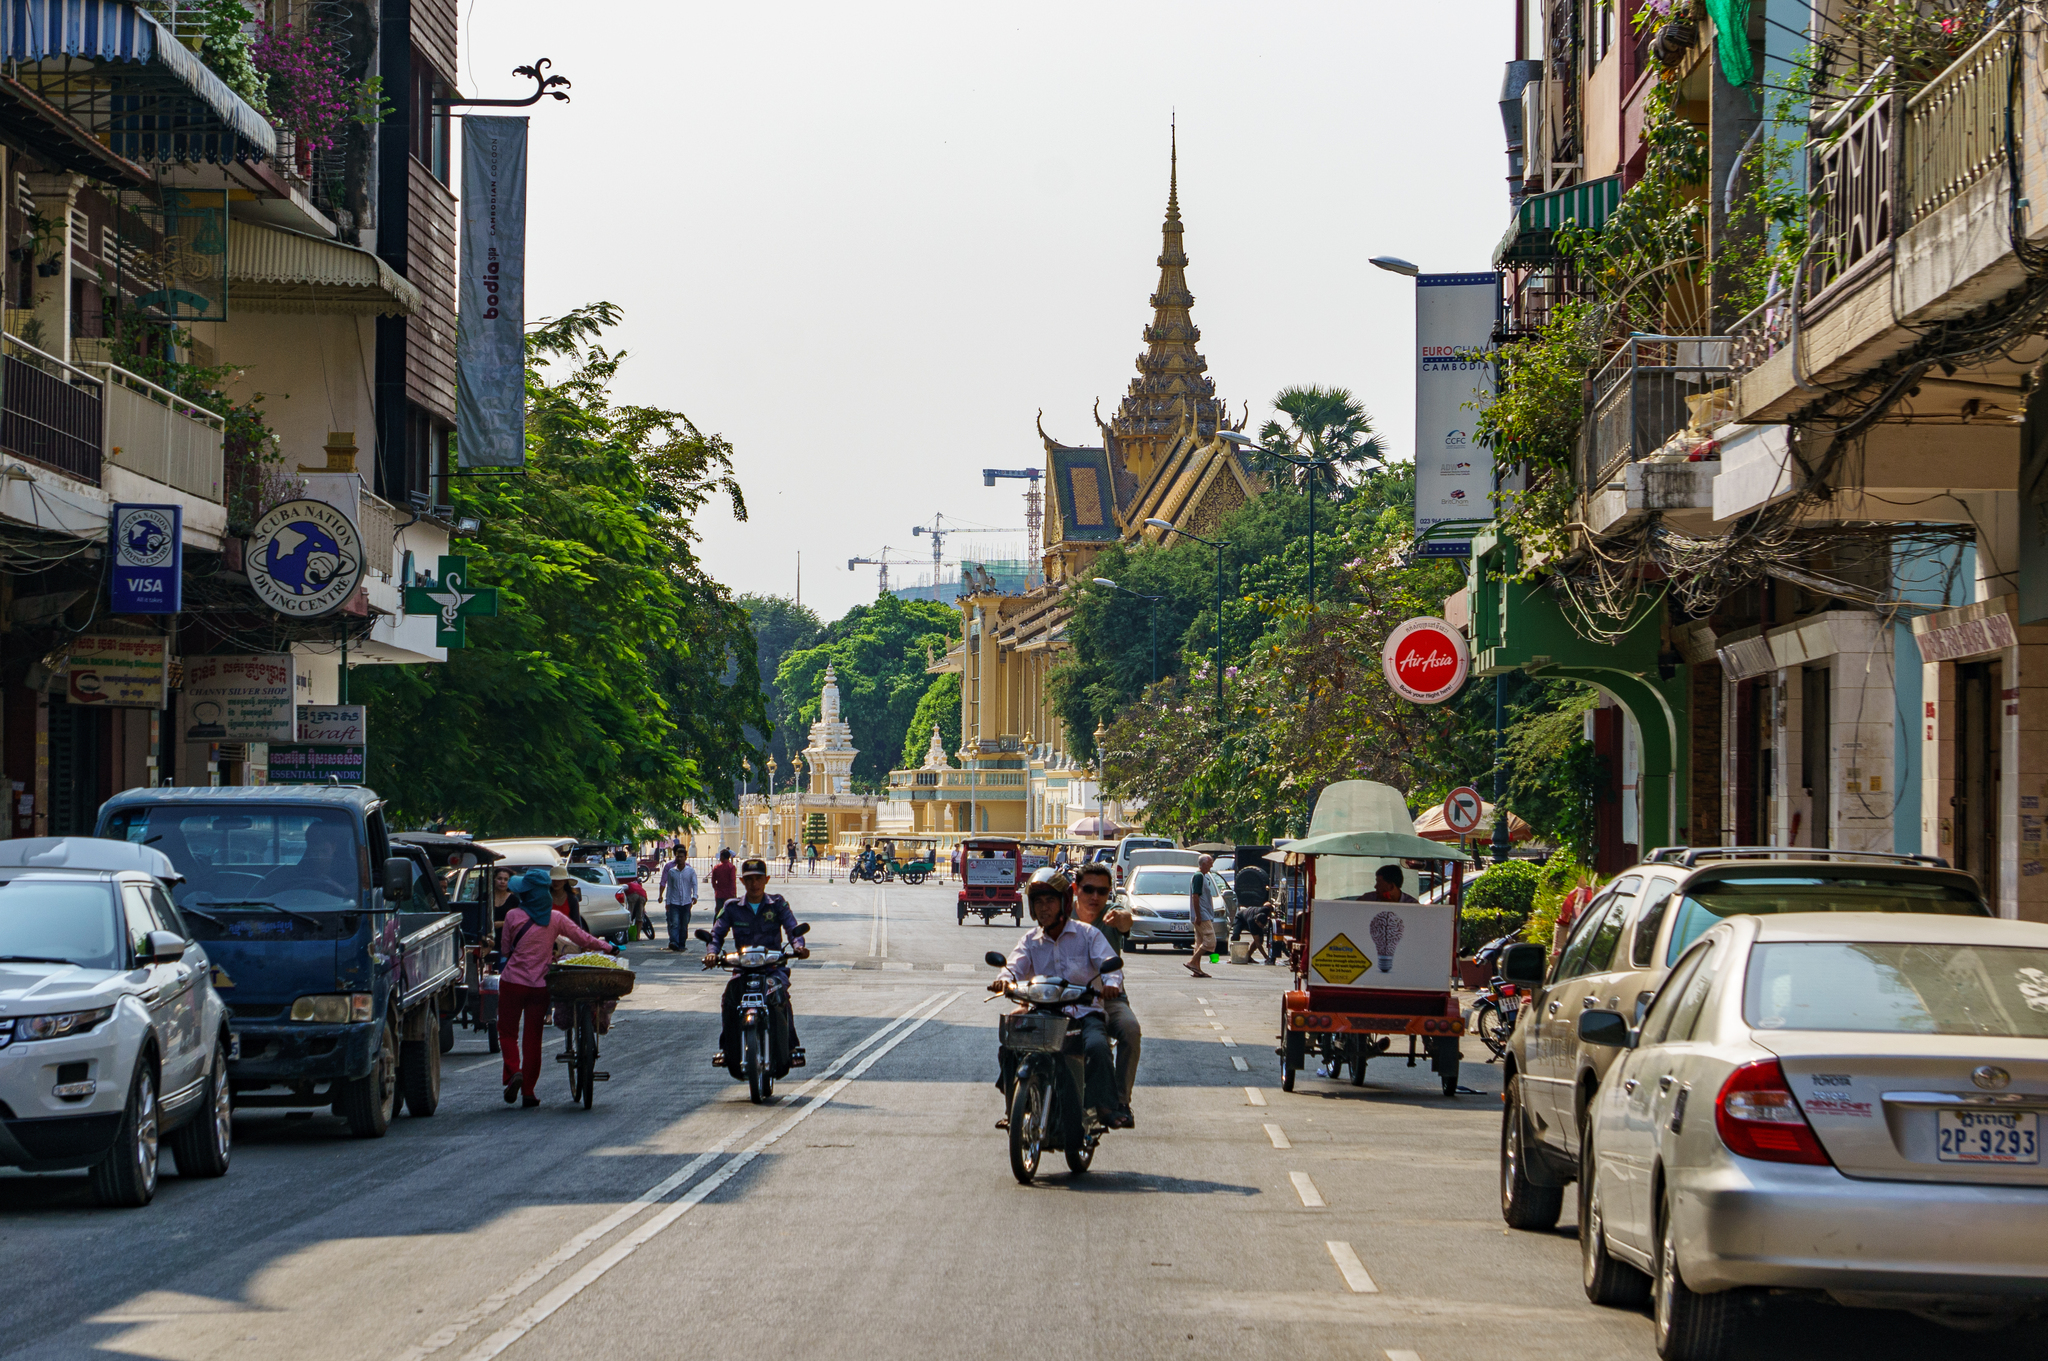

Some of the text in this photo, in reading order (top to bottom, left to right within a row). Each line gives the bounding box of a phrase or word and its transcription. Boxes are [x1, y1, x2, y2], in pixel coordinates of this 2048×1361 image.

[490, 247, 499, 261] spa
[483, 262, 500, 320] bodia
[1422, 362, 1490, 372] CAMBODIA
[1445, 437, 1467, 445] CCFC
[121, 512, 168, 533] SCUBA NATION
[256, 505, 353, 547] SCUBA NATION
[123, 546, 169, 565] DIVING CENTRE
[126, 578, 163, 592] VISA
[254, 574, 351, 612] DIVING CENTRE
[1400, 649, 1454, 673] AirAsia
[189, 687, 287, 696] CHANNY SILVER SHOP
[1399, 684, 1454, 699] Book your flight here!
[297, 724, 362, 742] dicraft
[270, 770, 317, 779] ESSENTIAL
[1941, 1128, 2035, 1154] 2P-9293
